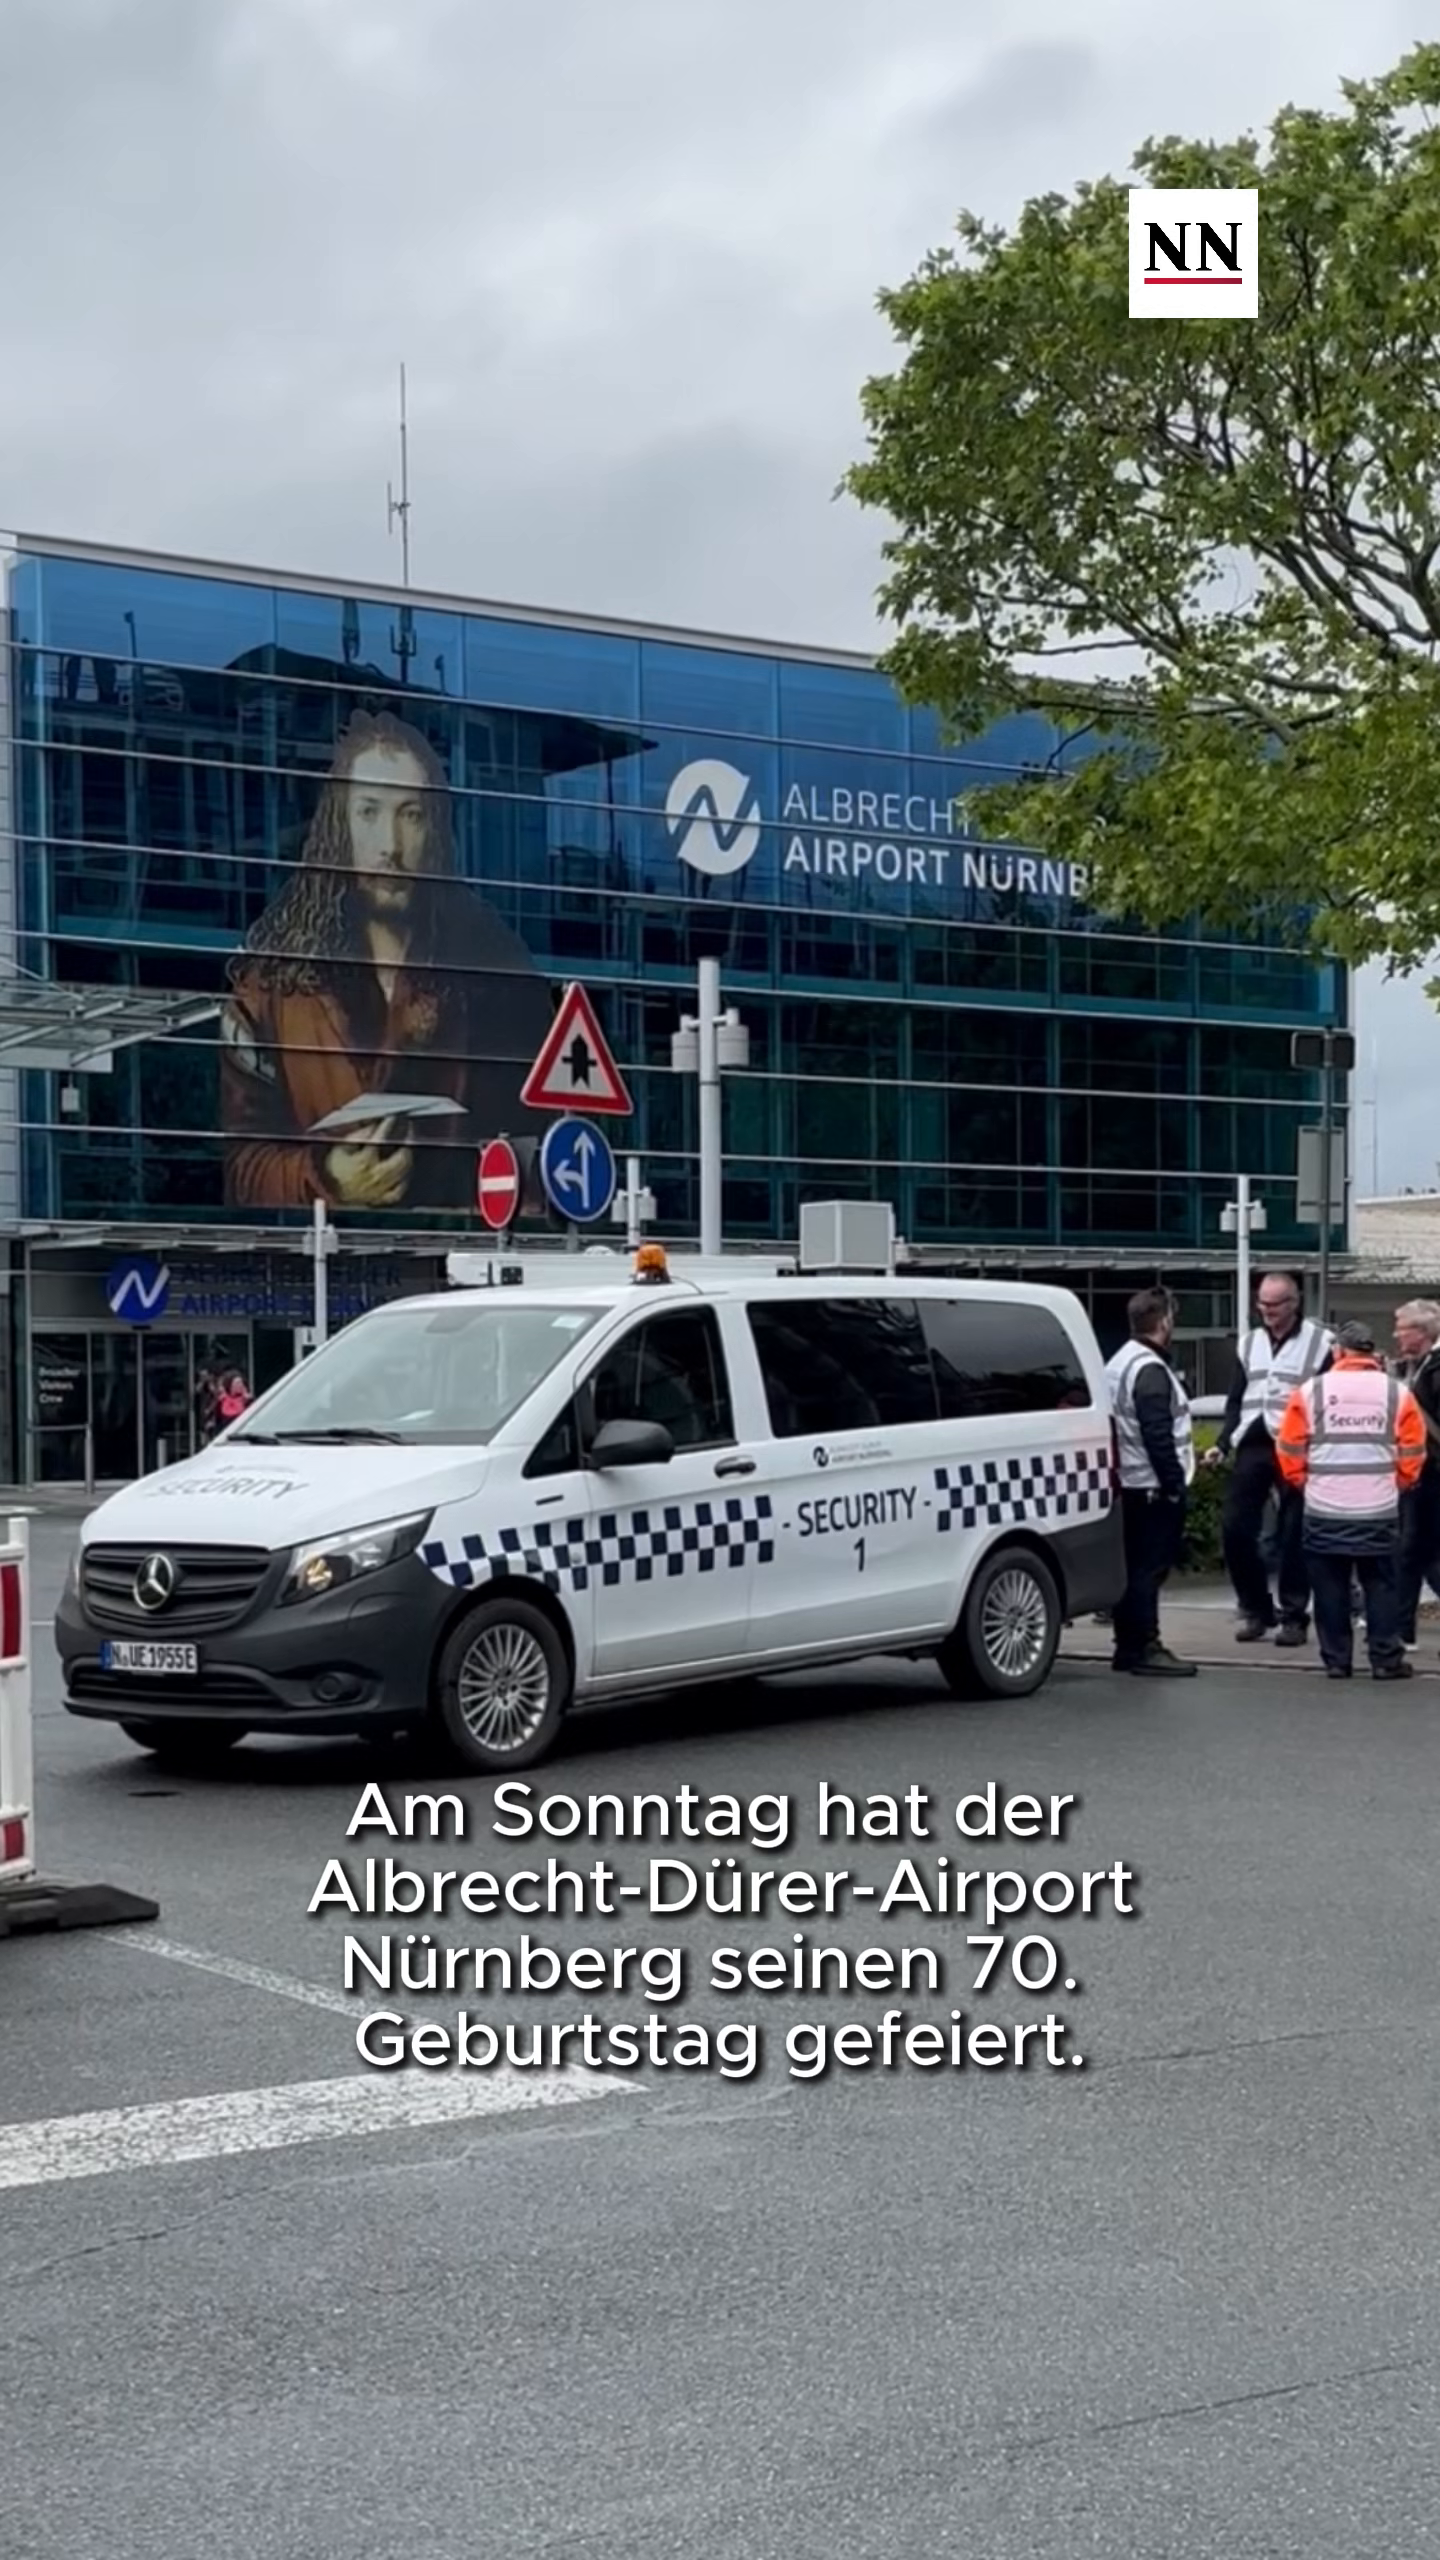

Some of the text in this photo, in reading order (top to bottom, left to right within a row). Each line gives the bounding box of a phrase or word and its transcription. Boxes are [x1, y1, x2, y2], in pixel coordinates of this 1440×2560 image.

[783, 784, 970, 837] ALBRECHT
[783, 837, 1102, 896] AIRPORT NÜRNB
[1329, 1413, 1386, 1430] Security
[158, 1476, 309, 1499] SECURITY
[798, 1486, 917, 1537] SECURITY
[853, 1537, 865, 1572] 1
